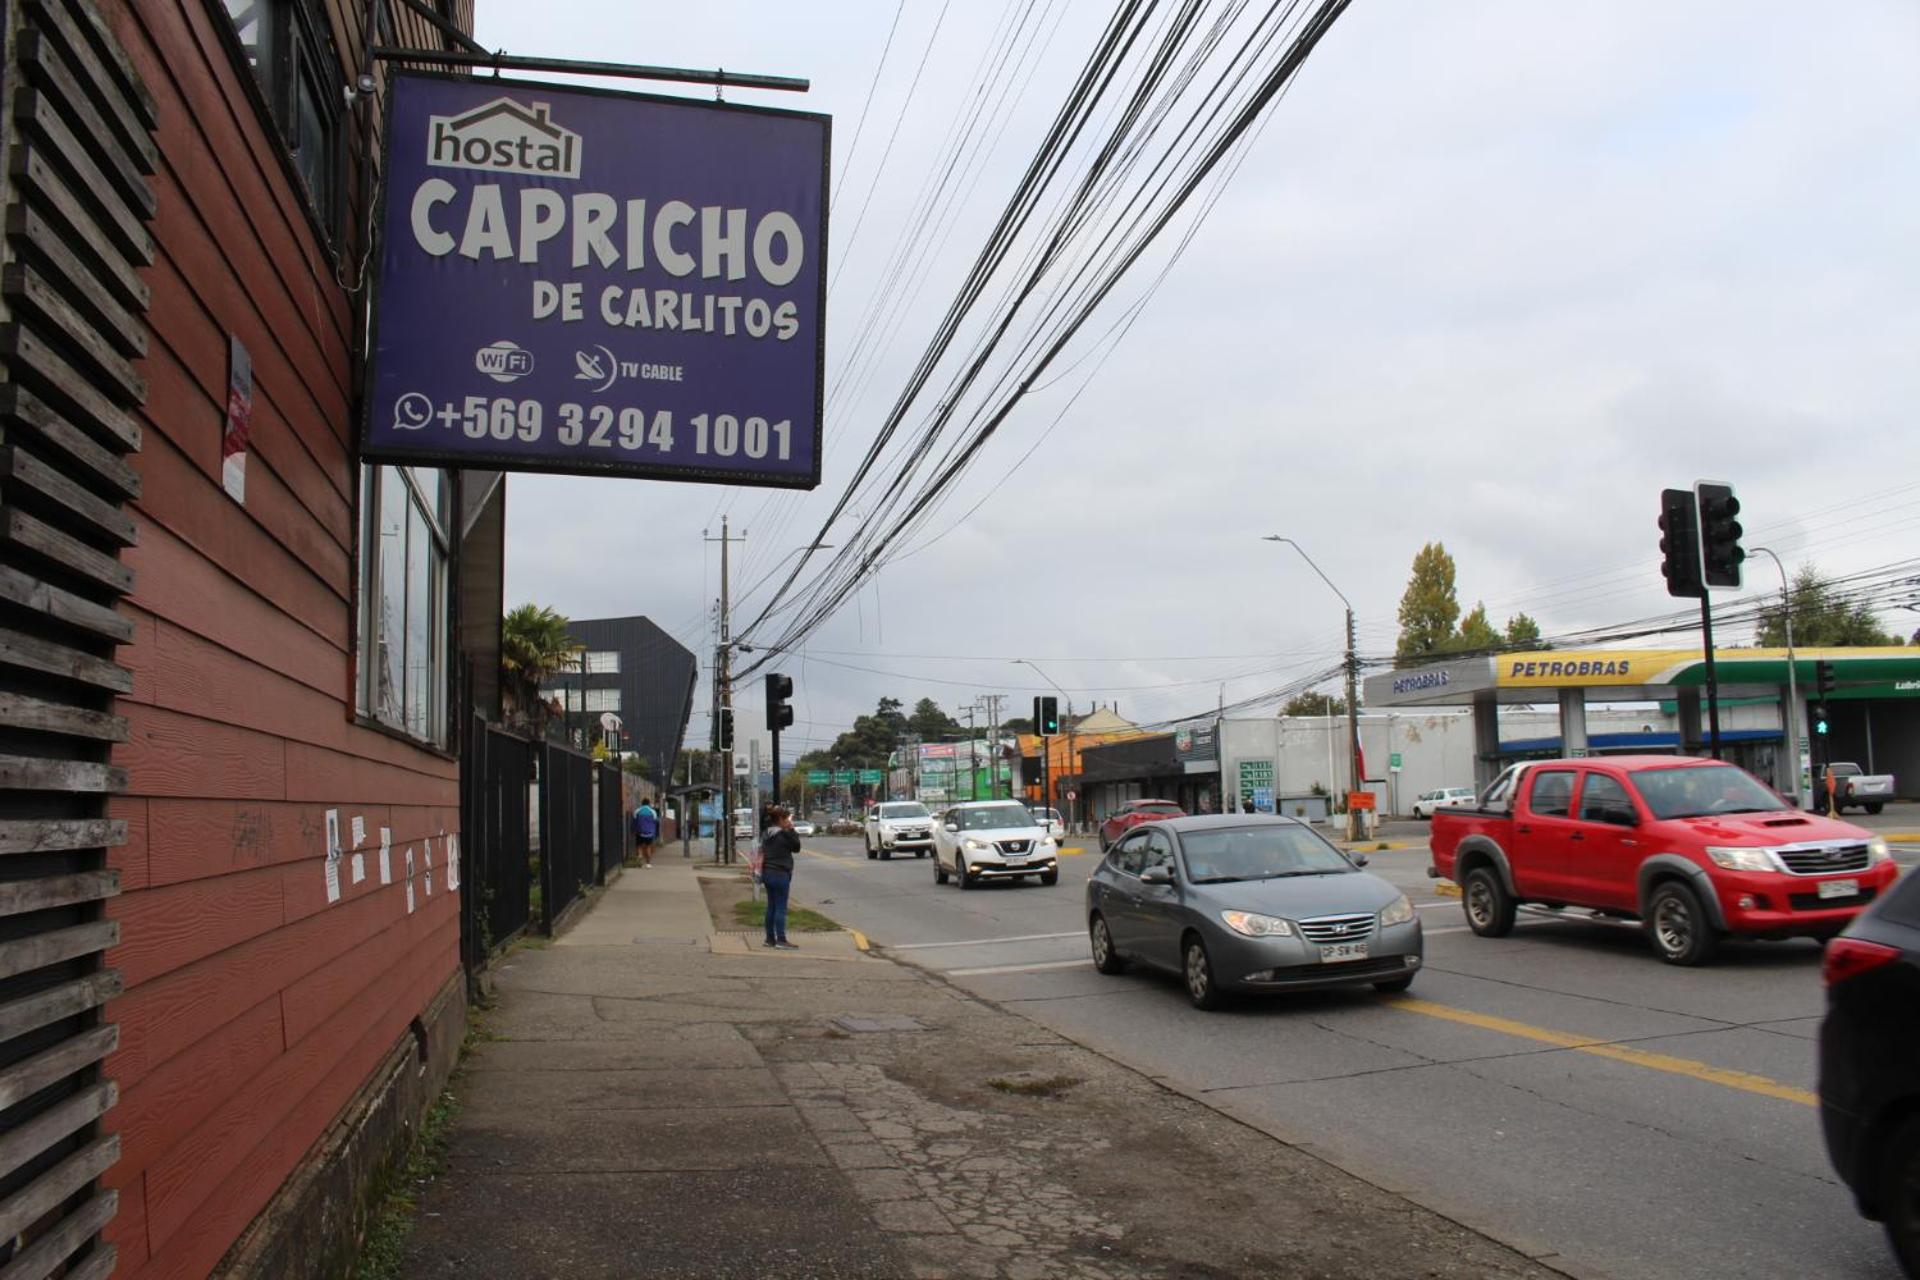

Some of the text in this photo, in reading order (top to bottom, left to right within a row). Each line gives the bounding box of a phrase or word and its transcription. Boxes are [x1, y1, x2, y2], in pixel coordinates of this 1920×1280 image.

[432, 121, 575, 173] hostal
[410, 178, 805, 287] CAPRICHO
[532, 279, 800, 341] DE CARLITOS
[620, 361, 684, 382] TV CABLE
[436, 395, 792, 461] +569 3294 1001
[1393, 671, 1448, 695] PETROBRAS
[1510, 660, 1631, 677] PETROBRAS
